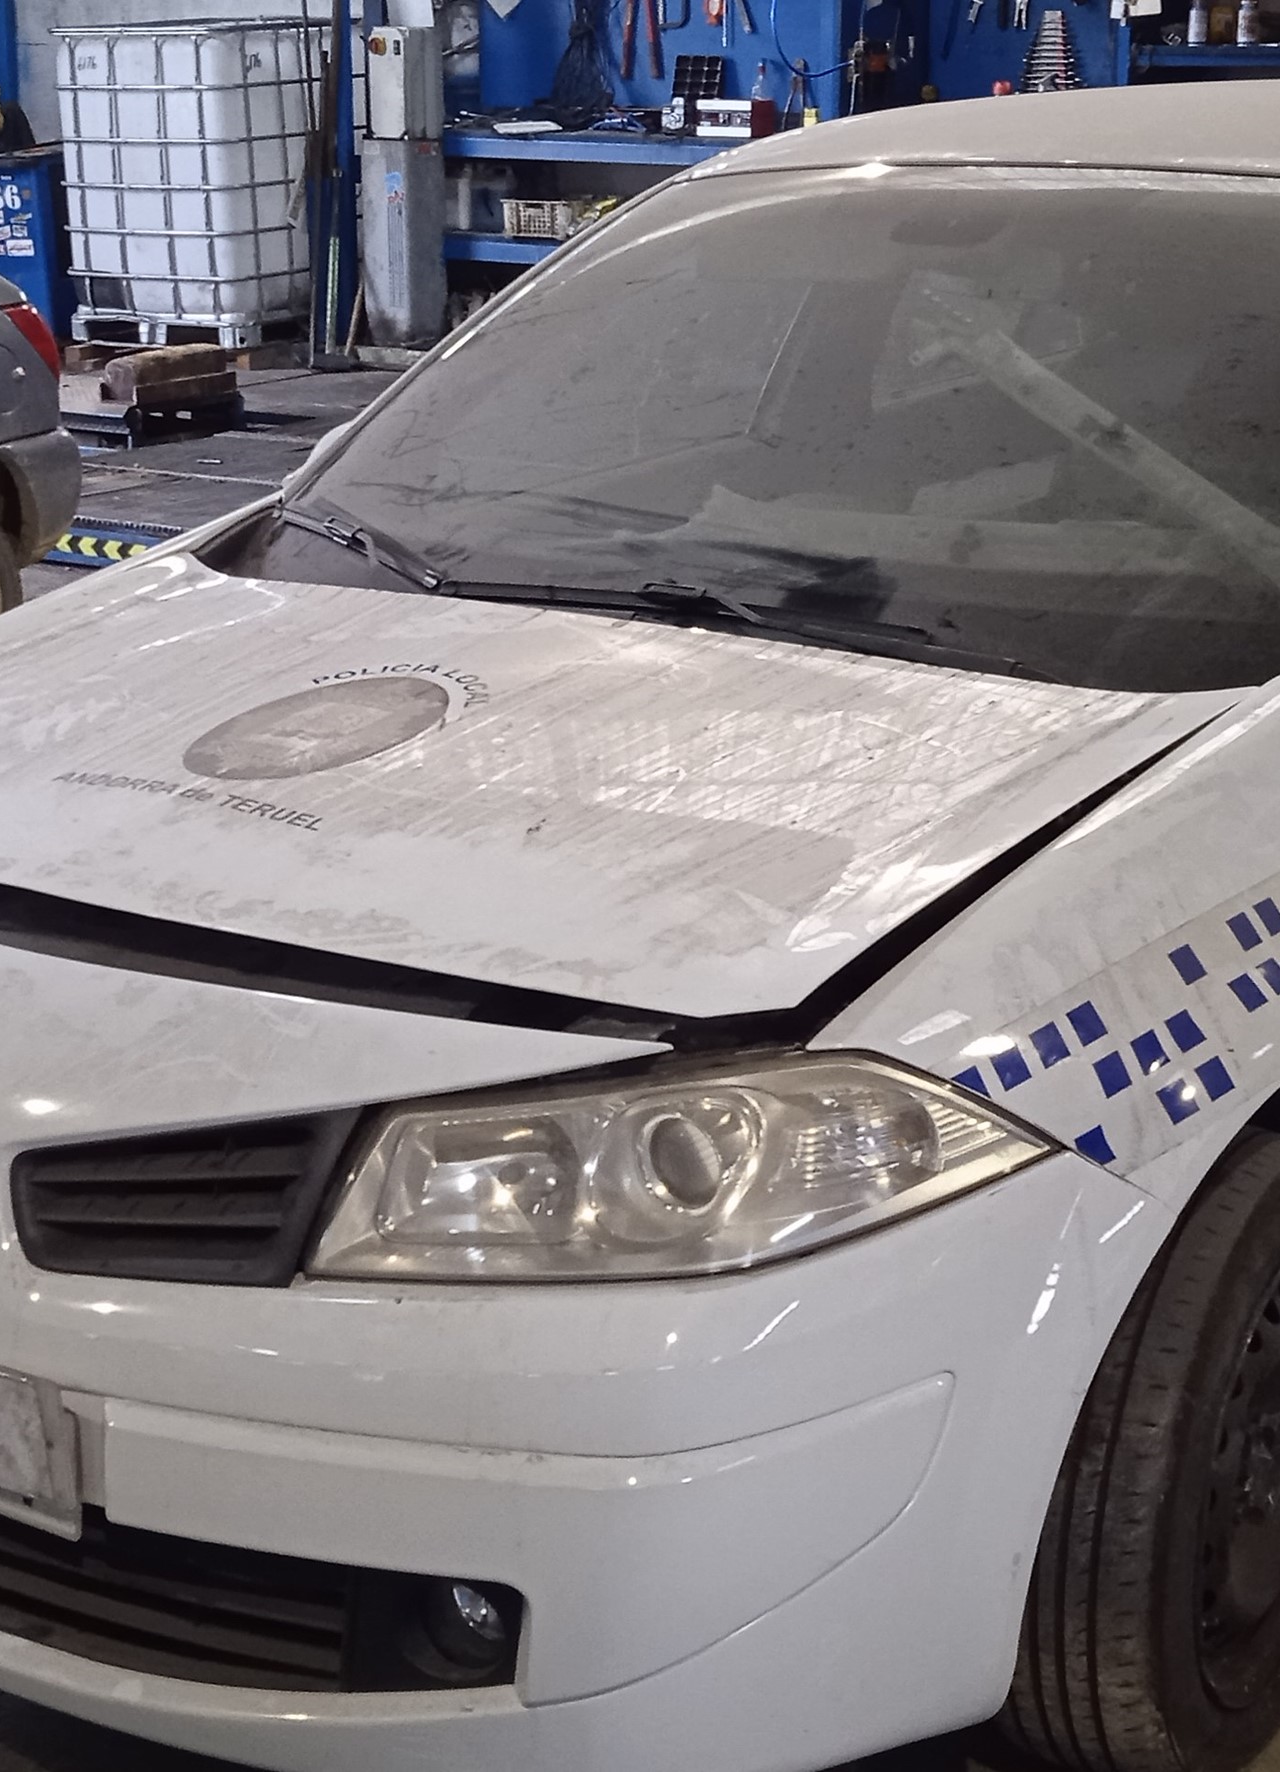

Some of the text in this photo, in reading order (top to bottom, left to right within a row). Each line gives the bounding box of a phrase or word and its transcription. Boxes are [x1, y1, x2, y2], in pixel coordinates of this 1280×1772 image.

[311, 664, 490, 708] POLICIA LOCAL
[51, 771, 324, 832] ANDORRA de TERUEL
